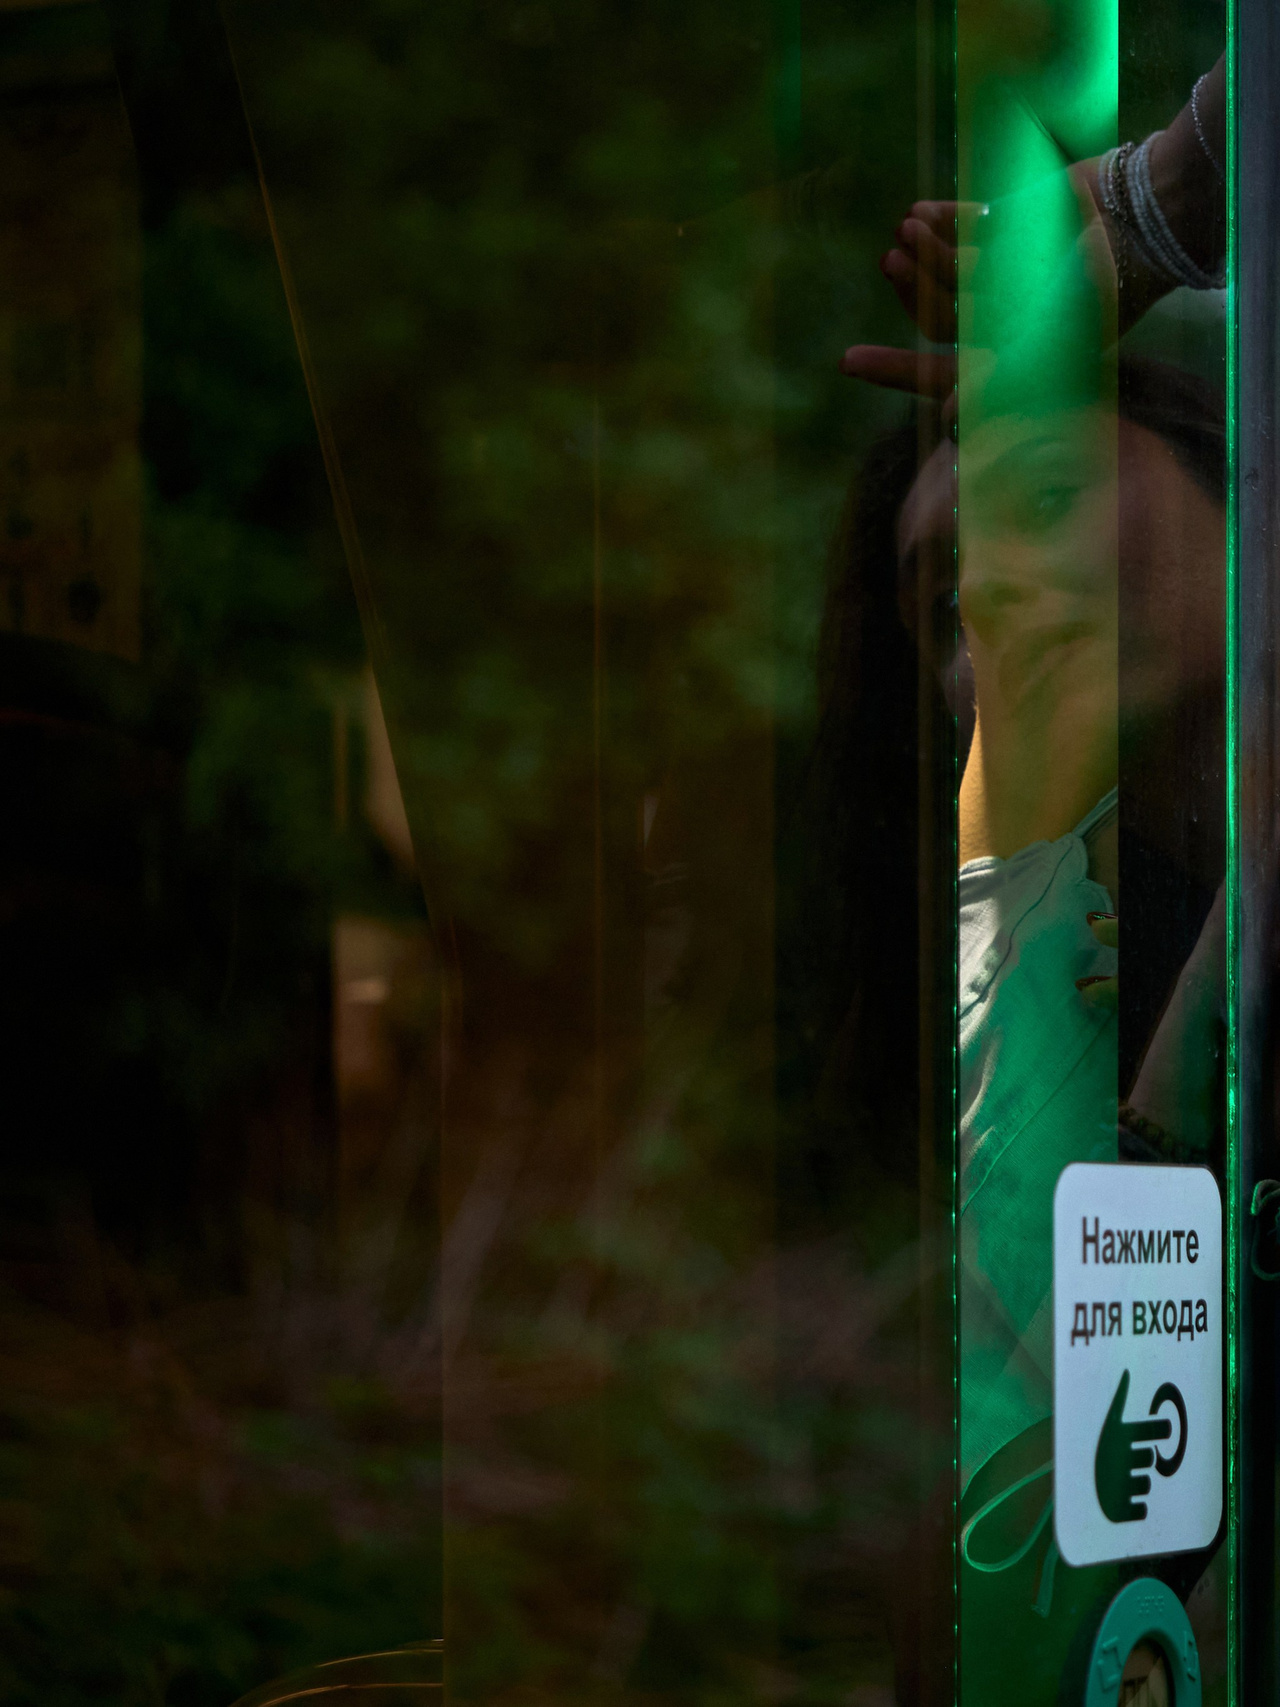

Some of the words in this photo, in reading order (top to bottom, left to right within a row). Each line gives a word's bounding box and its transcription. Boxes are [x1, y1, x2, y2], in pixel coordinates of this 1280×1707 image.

[1082, 1216, 1199, 1264] Нажмите
[1071, 1301, 1122, 1347] для
[1132, 1298, 1208, 1341] входа
